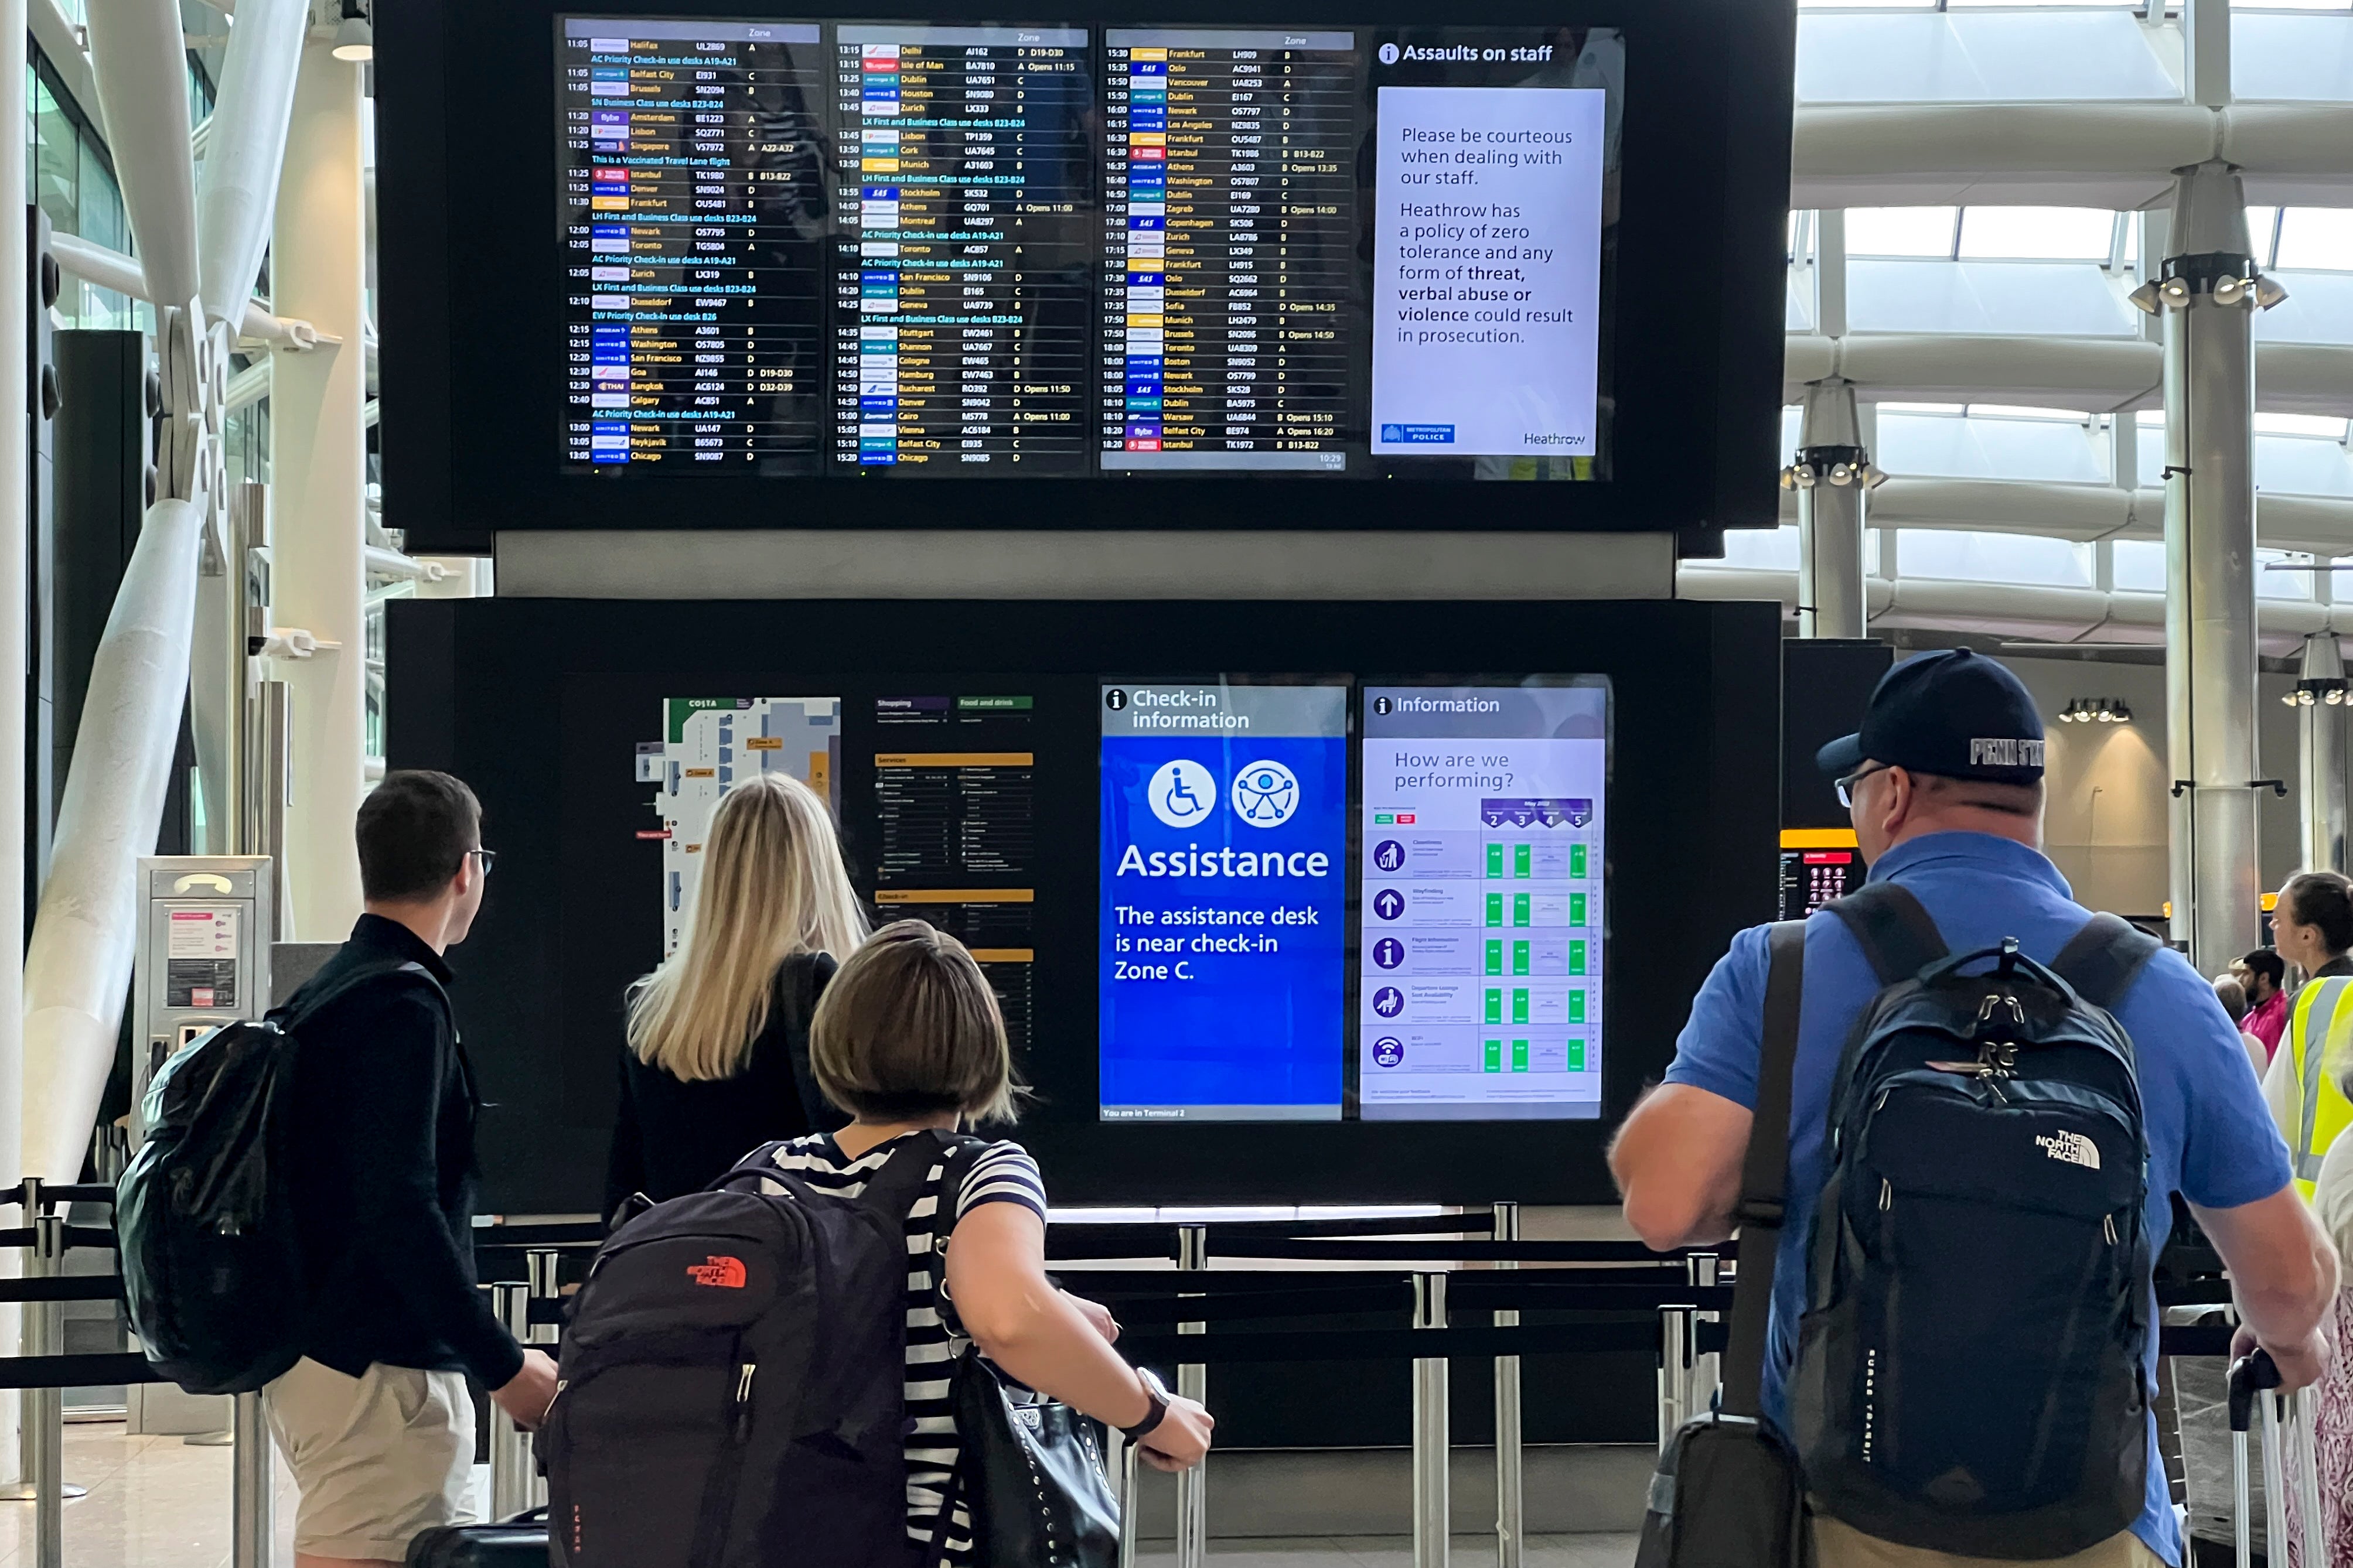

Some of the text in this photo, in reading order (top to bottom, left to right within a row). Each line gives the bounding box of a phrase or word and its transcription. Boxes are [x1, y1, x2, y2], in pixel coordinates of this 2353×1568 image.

[748, 28, 771, 37] Zone
[1018, 33, 1040, 42] Zone
[630, 41, 658, 50] Halifax
[1285, 36, 1307, 45] Zone
[1403, 45, 1553, 62] Assaults on staff
[926, 62, 944, 70] Man
[1028, 63, 1052, 72] Opens
[1169, 64, 1186, 72] Oslo
[630, 70, 657, 78] Belfast
[659, 70, 674, 80] City
[630, 128, 656, 136] Lisbon
[1182, 121, 1212, 130] Angeles
[1403, 128, 1572, 144] Please be courteous
[1401, 150, 1562, 167] when dealing with
[1167, 177, 1212, 186] Washington
[1401, 171, 1478, 185] our staff.
[1401, 203, 1520, 217] Heathrow has
[1400, 224, 1529, 241] a policy of zero
[604, 255, 632, 264] Priority
[634, 256, 666, 264] Check-in
[682, 256, 702, 264] desks
[1400, 245, 1553, 262] tolerance and any
[1399, 266, 1525, 281] form of threat,
[1399, 287, 1532, 301] verbal abuse or
[1399, 308, 1573, 322] violence could result
[899, 329, 934, 338] Stuttgart
[1398, 328, 1525, 345] in prosecution.
[630, 340, 677, 349] Washington
[630, 382, 663, 392] Bangkok
[899, 385, 935, 393] Bucharest
[1287, 414, 1311, 422] Opens
[1524, 433, 1585, 445] Heathrow
[630, 452, 661, 461] Chicago
[1133, 690, 1216, 707] Check-in
[1397, 697, 1499, 712] Information
[1133, 711, 1249, 728] information
[1970, 739, 2018, 766] PENN
[1396, 753, 1509, 767] How are we
[1395, 772, 1514, 791] performing?
[1491, 816, 1581, 825] 2 3 4 5
[1116, 843, 1328, 877] Assistance
[1115, 906, 1318, 924] The assistance desk
[1116, 934, 1278, 952] is near check-in
[1114, 961, 1194, 979] Zone C.
[2035, 1135, 2079, 1154] NORTH
[2058, 1130, 2082, 1145] THE
[2048, 1148, 2079, 1163] FACE
